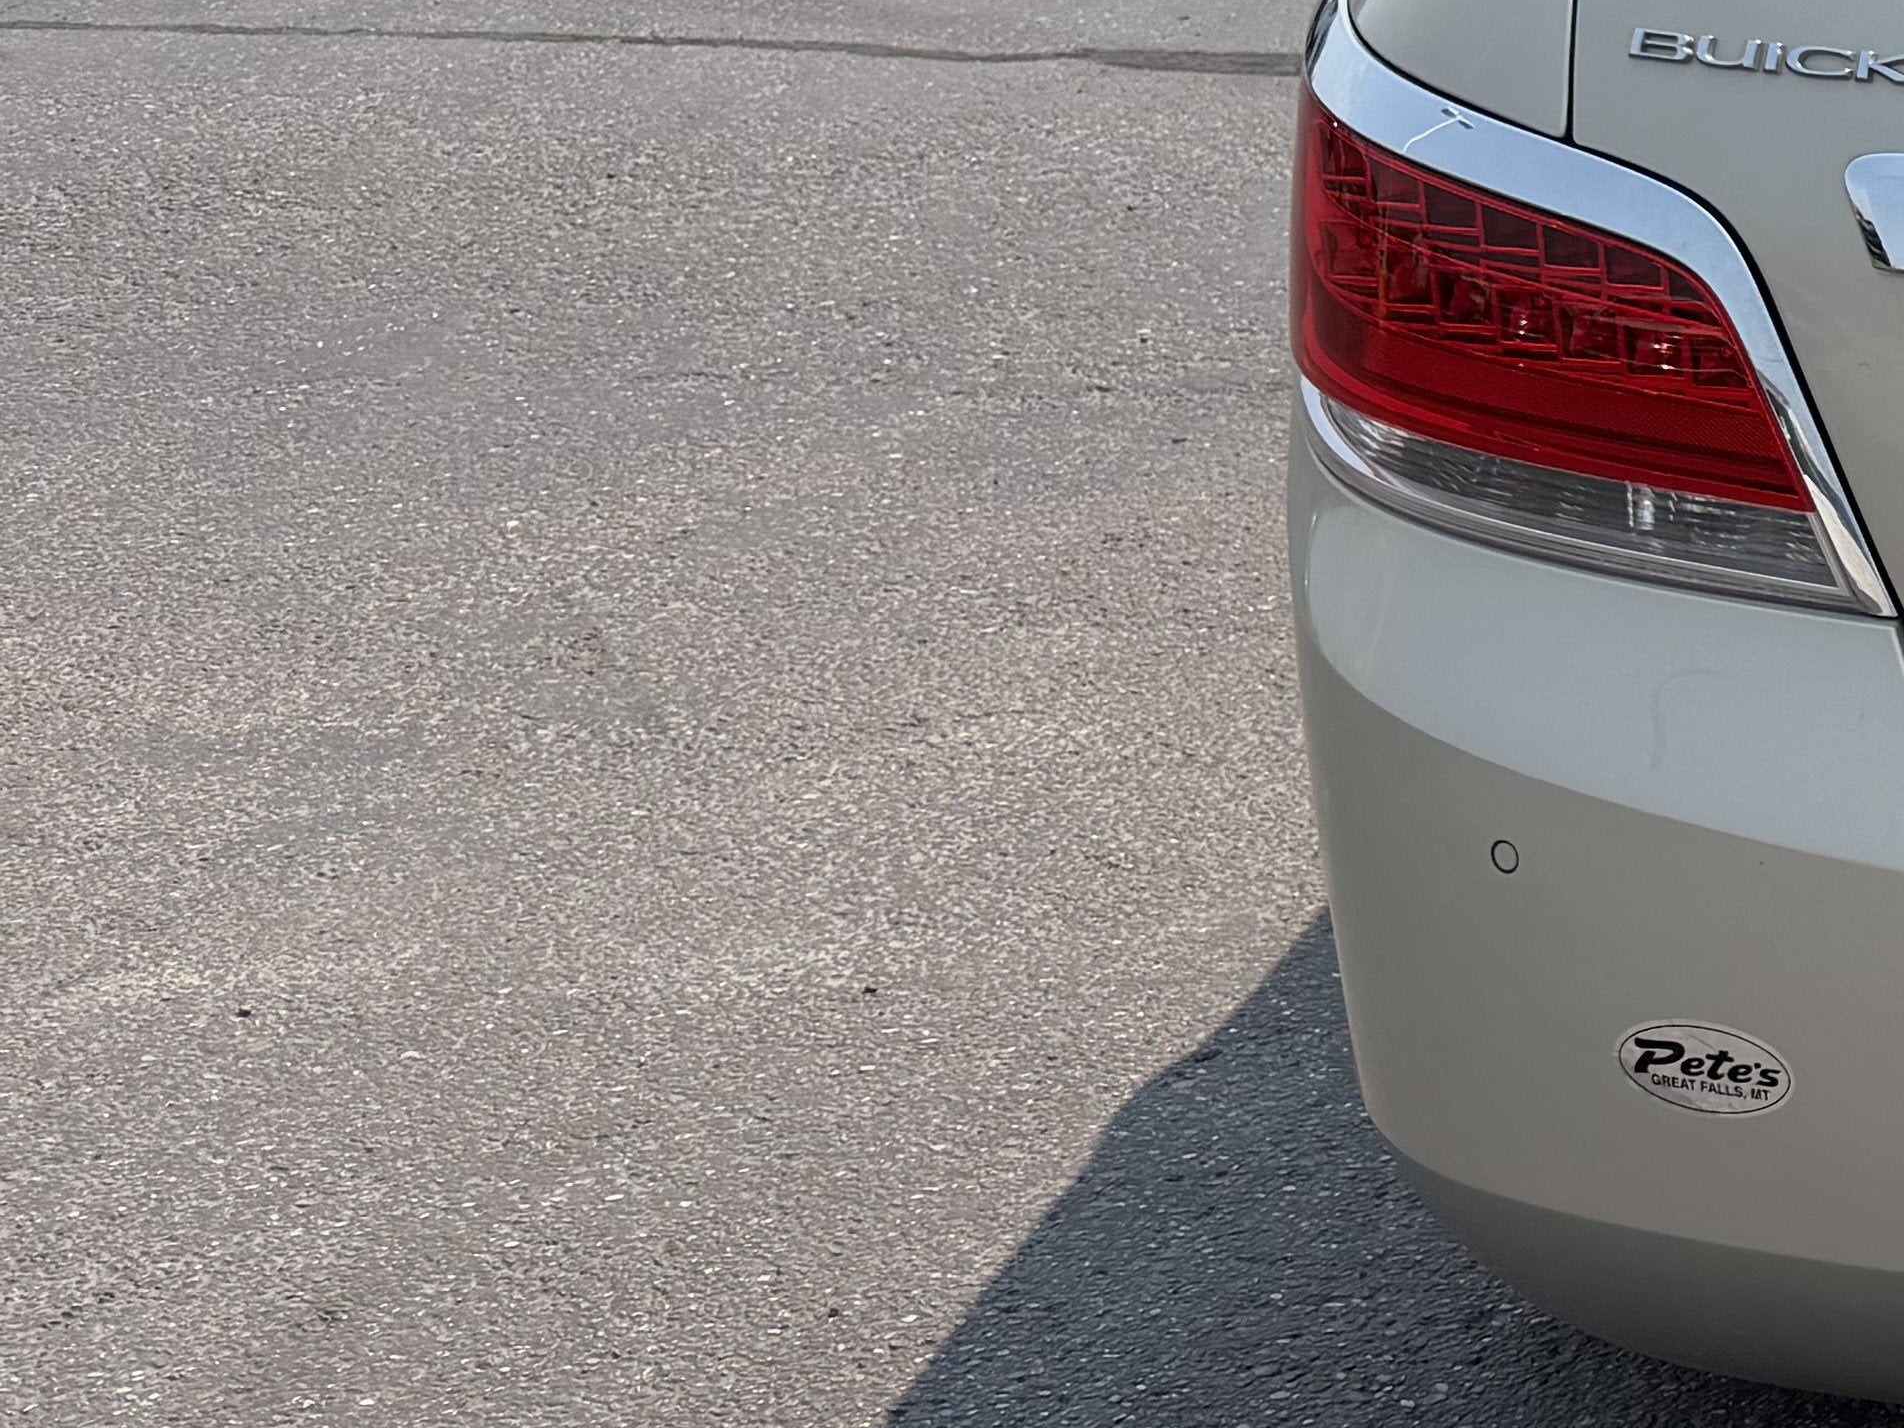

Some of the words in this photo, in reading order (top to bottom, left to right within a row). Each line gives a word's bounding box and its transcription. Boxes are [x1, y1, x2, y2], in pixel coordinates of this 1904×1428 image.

[1634, 1036, 1782, 1088] Pete's
[1651, 1073, 1697, 1091] GREAT
[1700, 1080, 1749, 1101] FALLS,
[1750, 1087, 1771, 1102] MT
